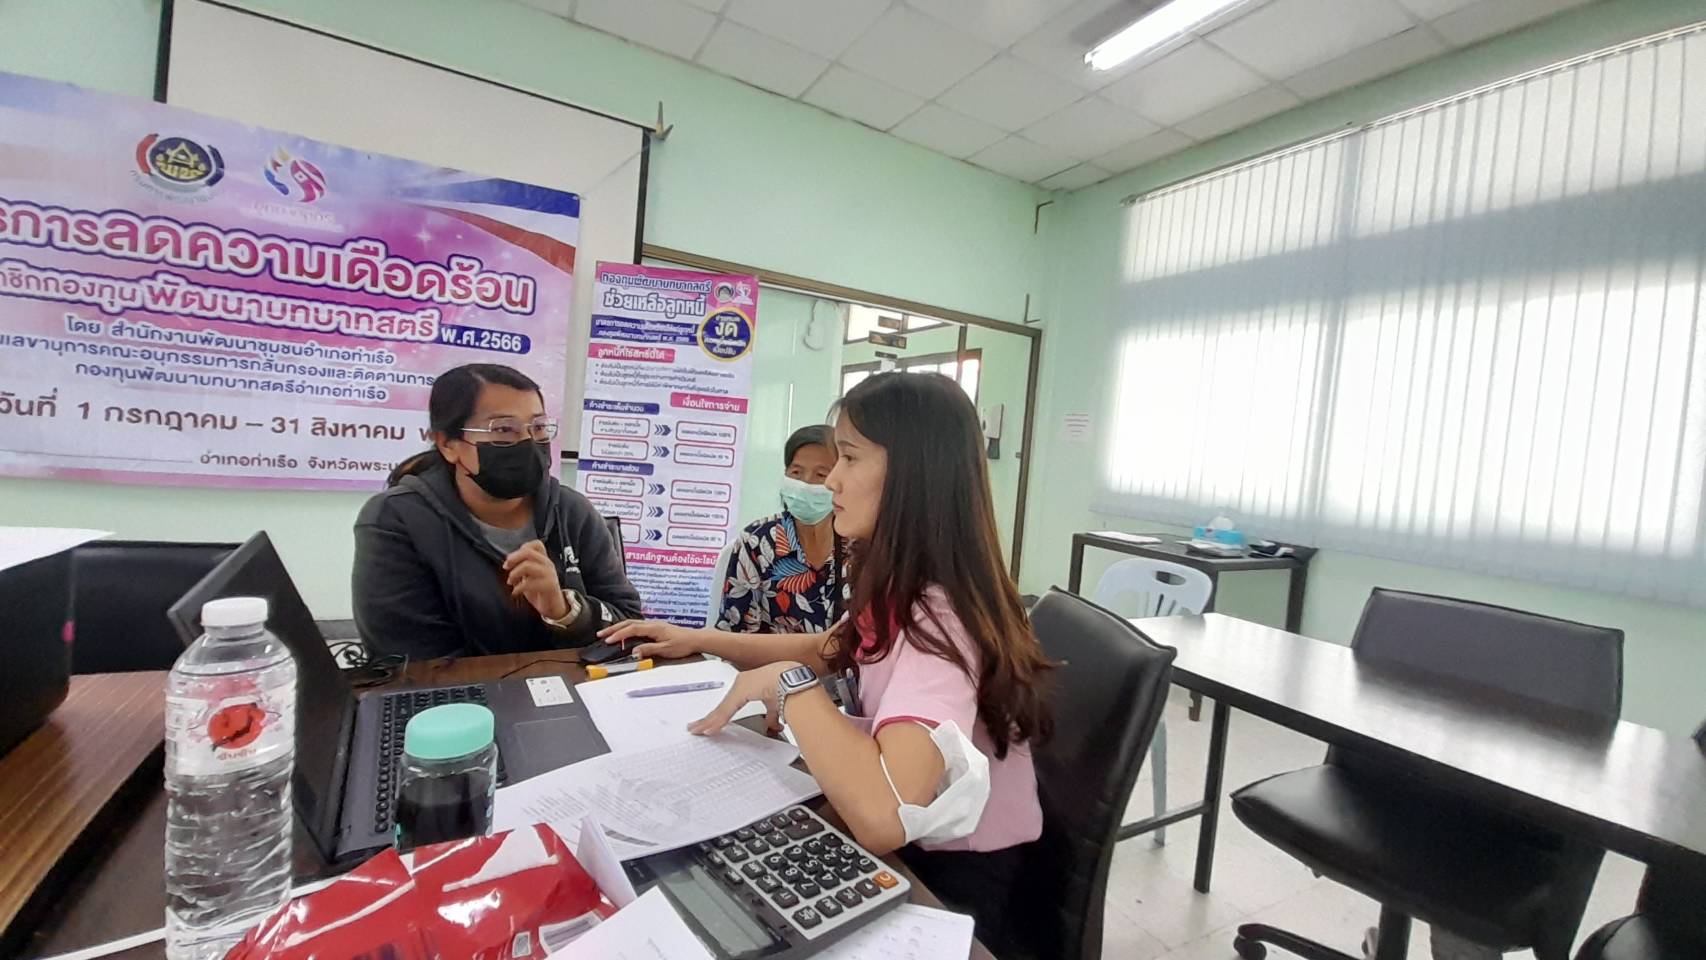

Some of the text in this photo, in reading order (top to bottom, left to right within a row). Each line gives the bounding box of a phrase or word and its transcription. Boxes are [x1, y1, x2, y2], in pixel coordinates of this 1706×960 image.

[67, 315, 101, 334] โดย
[714, 322, 738, 338] งด
[440, 325, 522, 351] พ.ศ.2566
[0, 334, 434, 386] เลขานุการคณะอนุกรรมการกลั่นกรองและติดตามการ
[78, 402, 90, 420] 1
[104, 406, 236, 431] กรกฎาคม
[271, 417, 299, 434] 31
[310, 416, 405, 441] สิงหาคม
